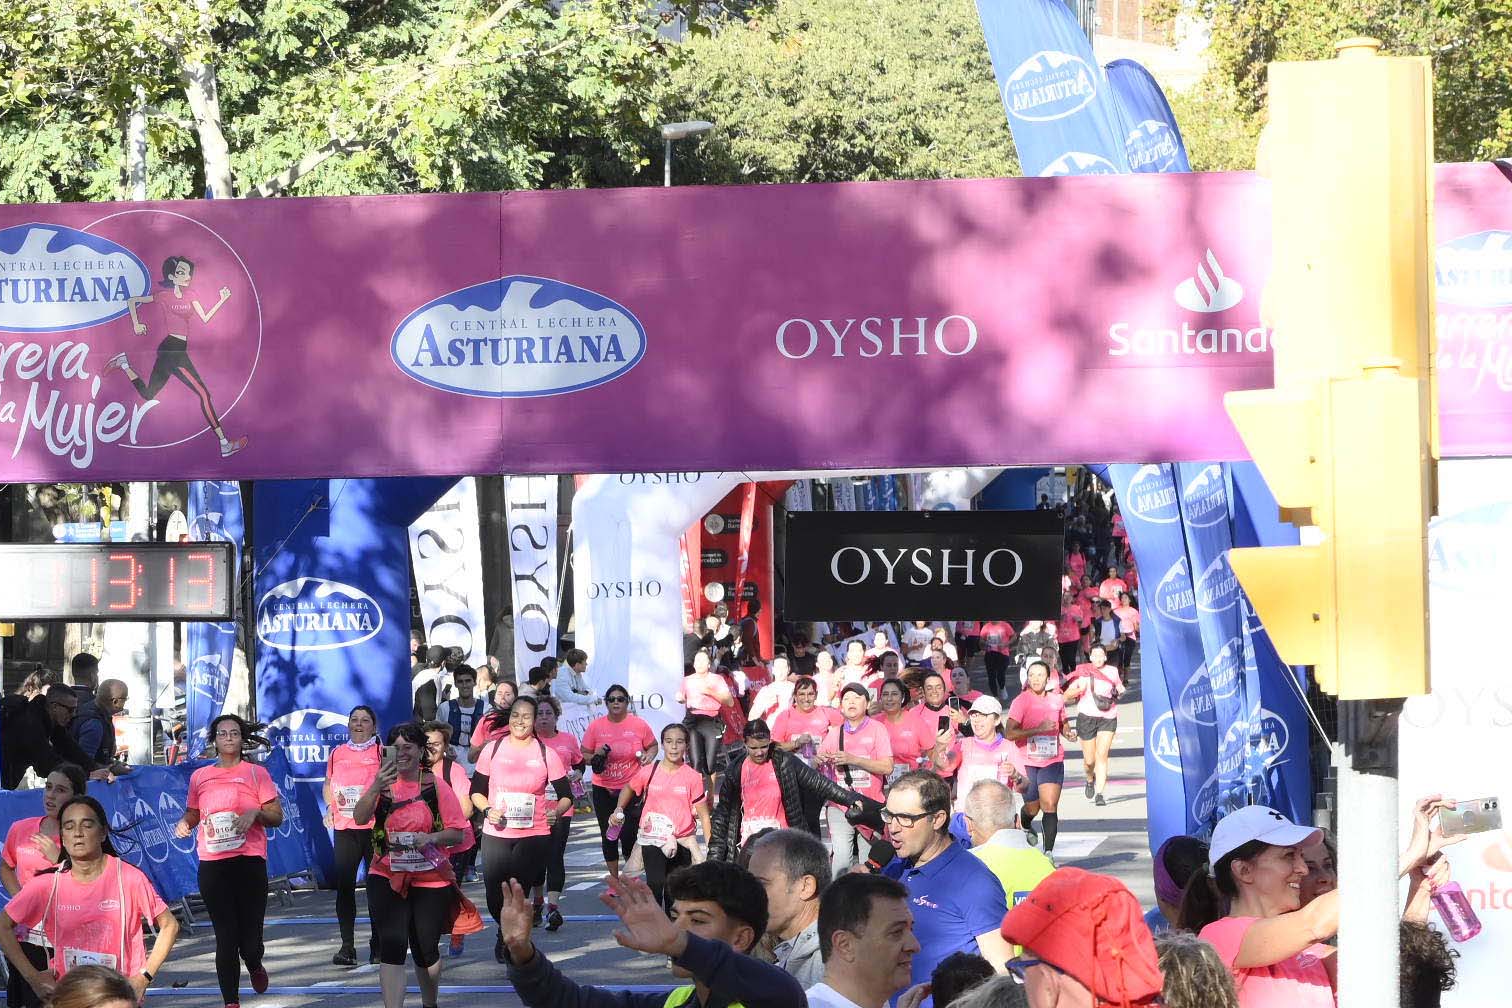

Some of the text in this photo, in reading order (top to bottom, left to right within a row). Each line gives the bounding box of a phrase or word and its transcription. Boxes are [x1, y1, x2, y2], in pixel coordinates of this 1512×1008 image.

[53, 259, 126, 272] LECHERA
[449, 316, 618, 332] CENTRAL LECHERA
[775, 314, 979, 360] OYSHO
[411, 323, 626, 368] ASTURIANA
[1108, 321, 1275, 356] Santand
[11, 375, 161, 469] Mujer
[829, 546, 1024, 587] OYSHO
[586, 580, 662, 600] OYSHO
[273, 601, 369, 611] CENTRAL LECHERA
[260, 607, 374, 634] ASTURIANA
[320, 732, 351, 742] LECH
